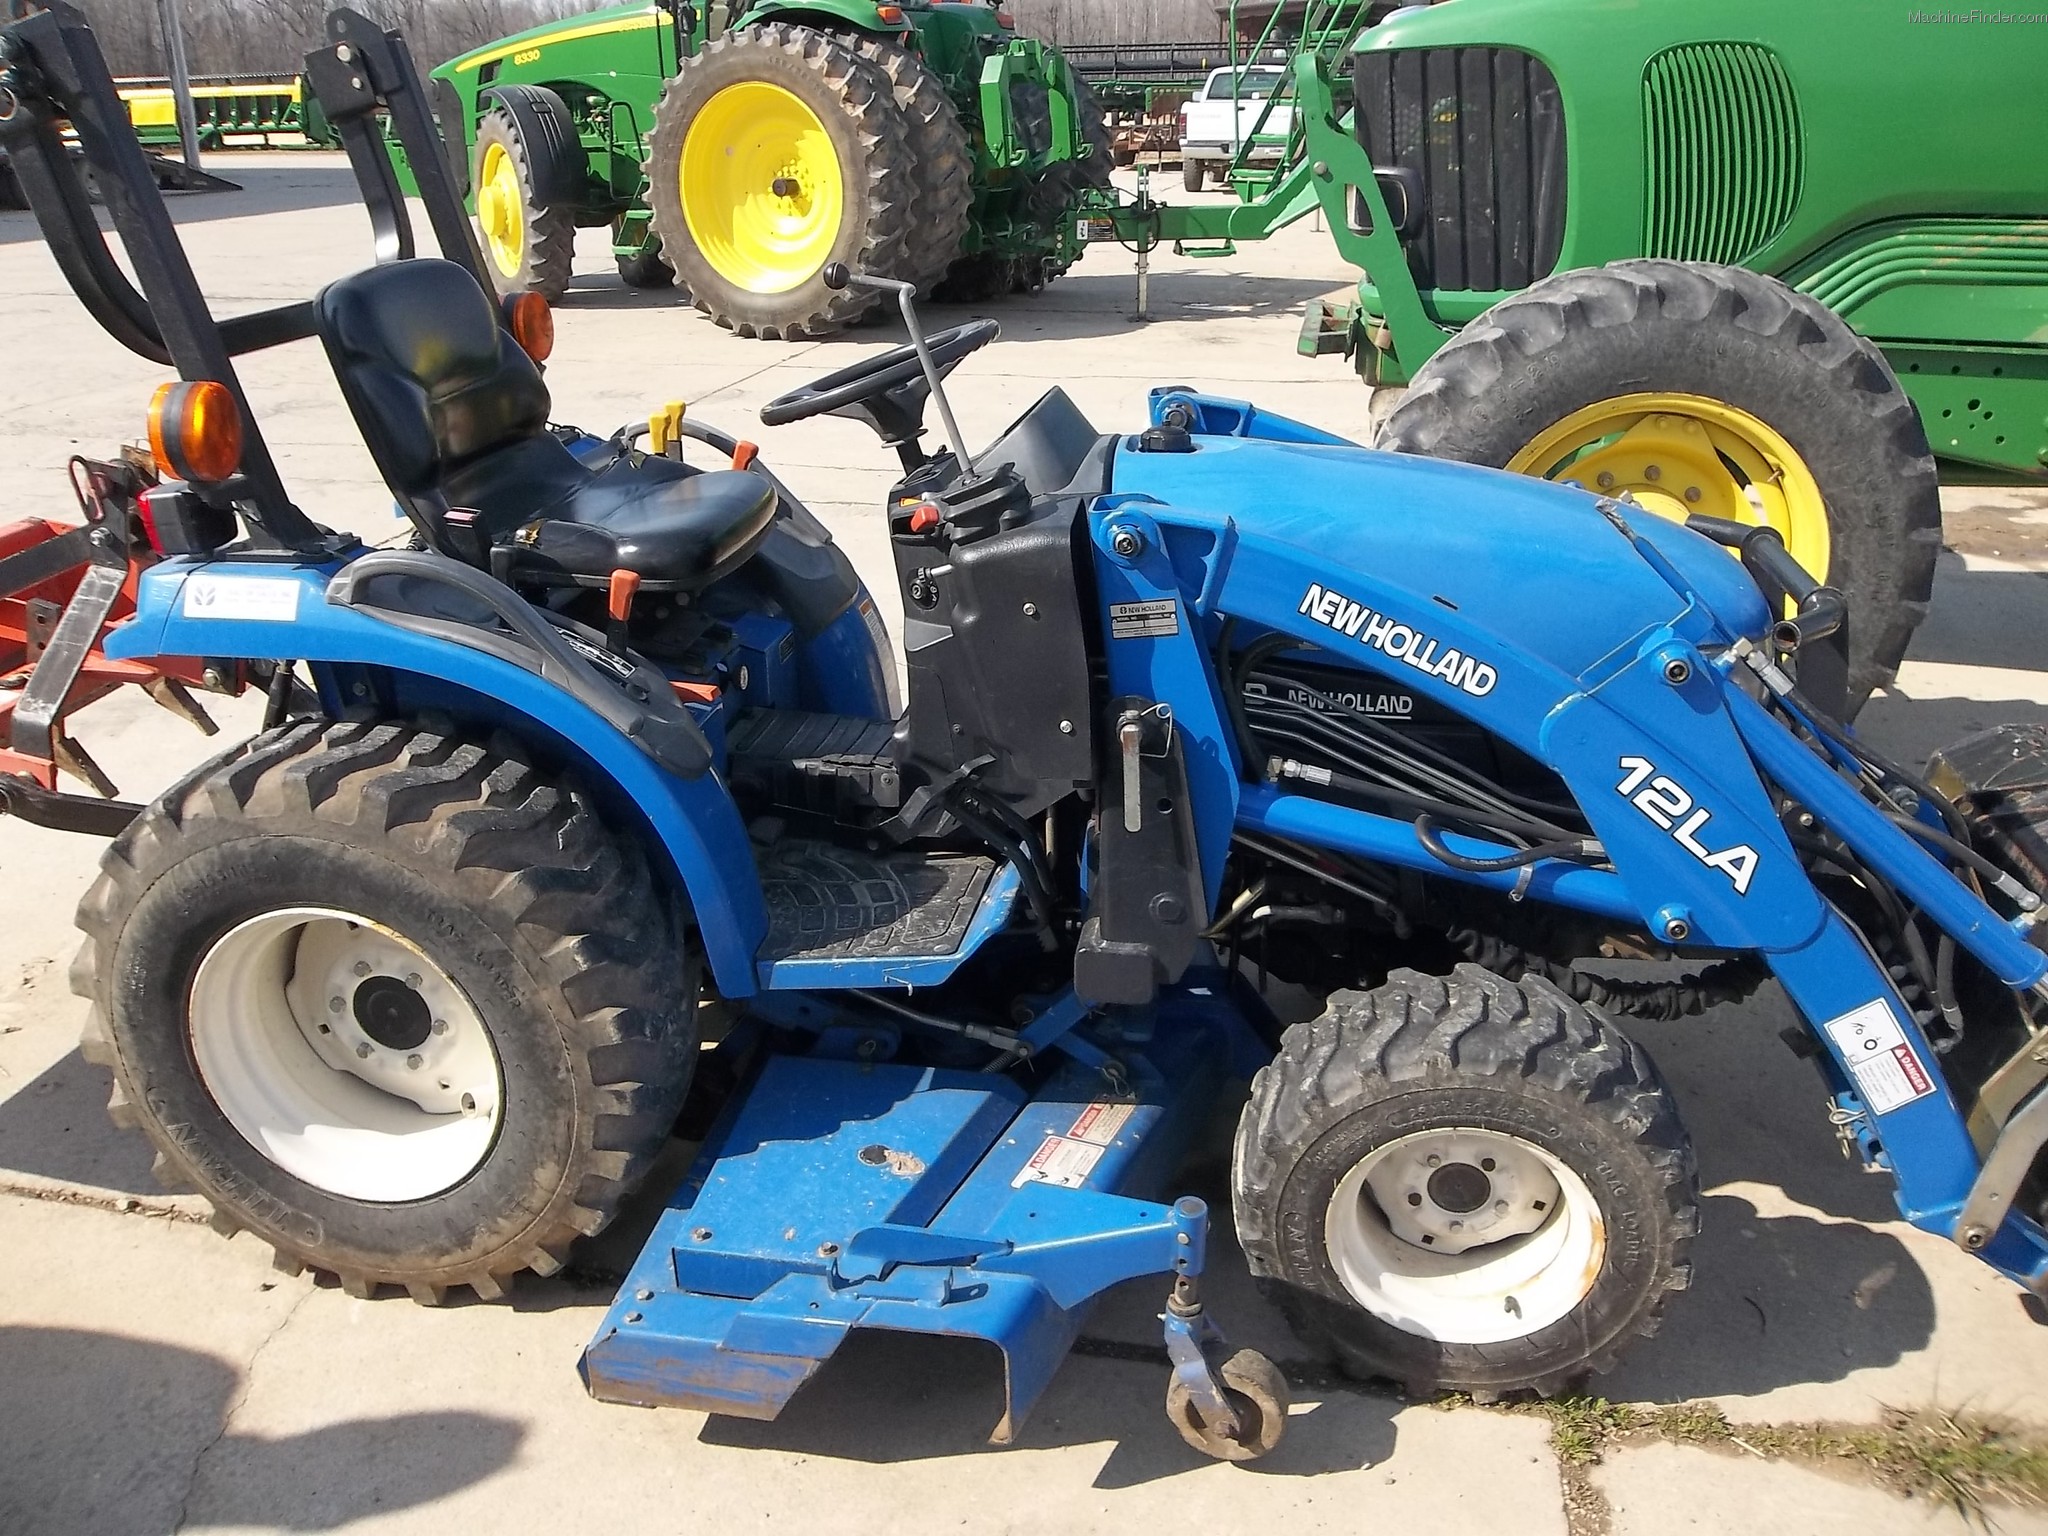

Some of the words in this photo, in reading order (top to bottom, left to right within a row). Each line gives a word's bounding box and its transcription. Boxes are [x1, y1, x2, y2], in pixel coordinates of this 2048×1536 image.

[513, 49, 541, 66] 8330
[1297, 582, 1371, 638] NEW
[1359, 611, 1498, 697] HOLLAND
[1328, 692, 1413, 714] HOLLAND
[1615, 756, 1760, 897] 12LA
[1900, 1056, 1928, 1092] DANGER
